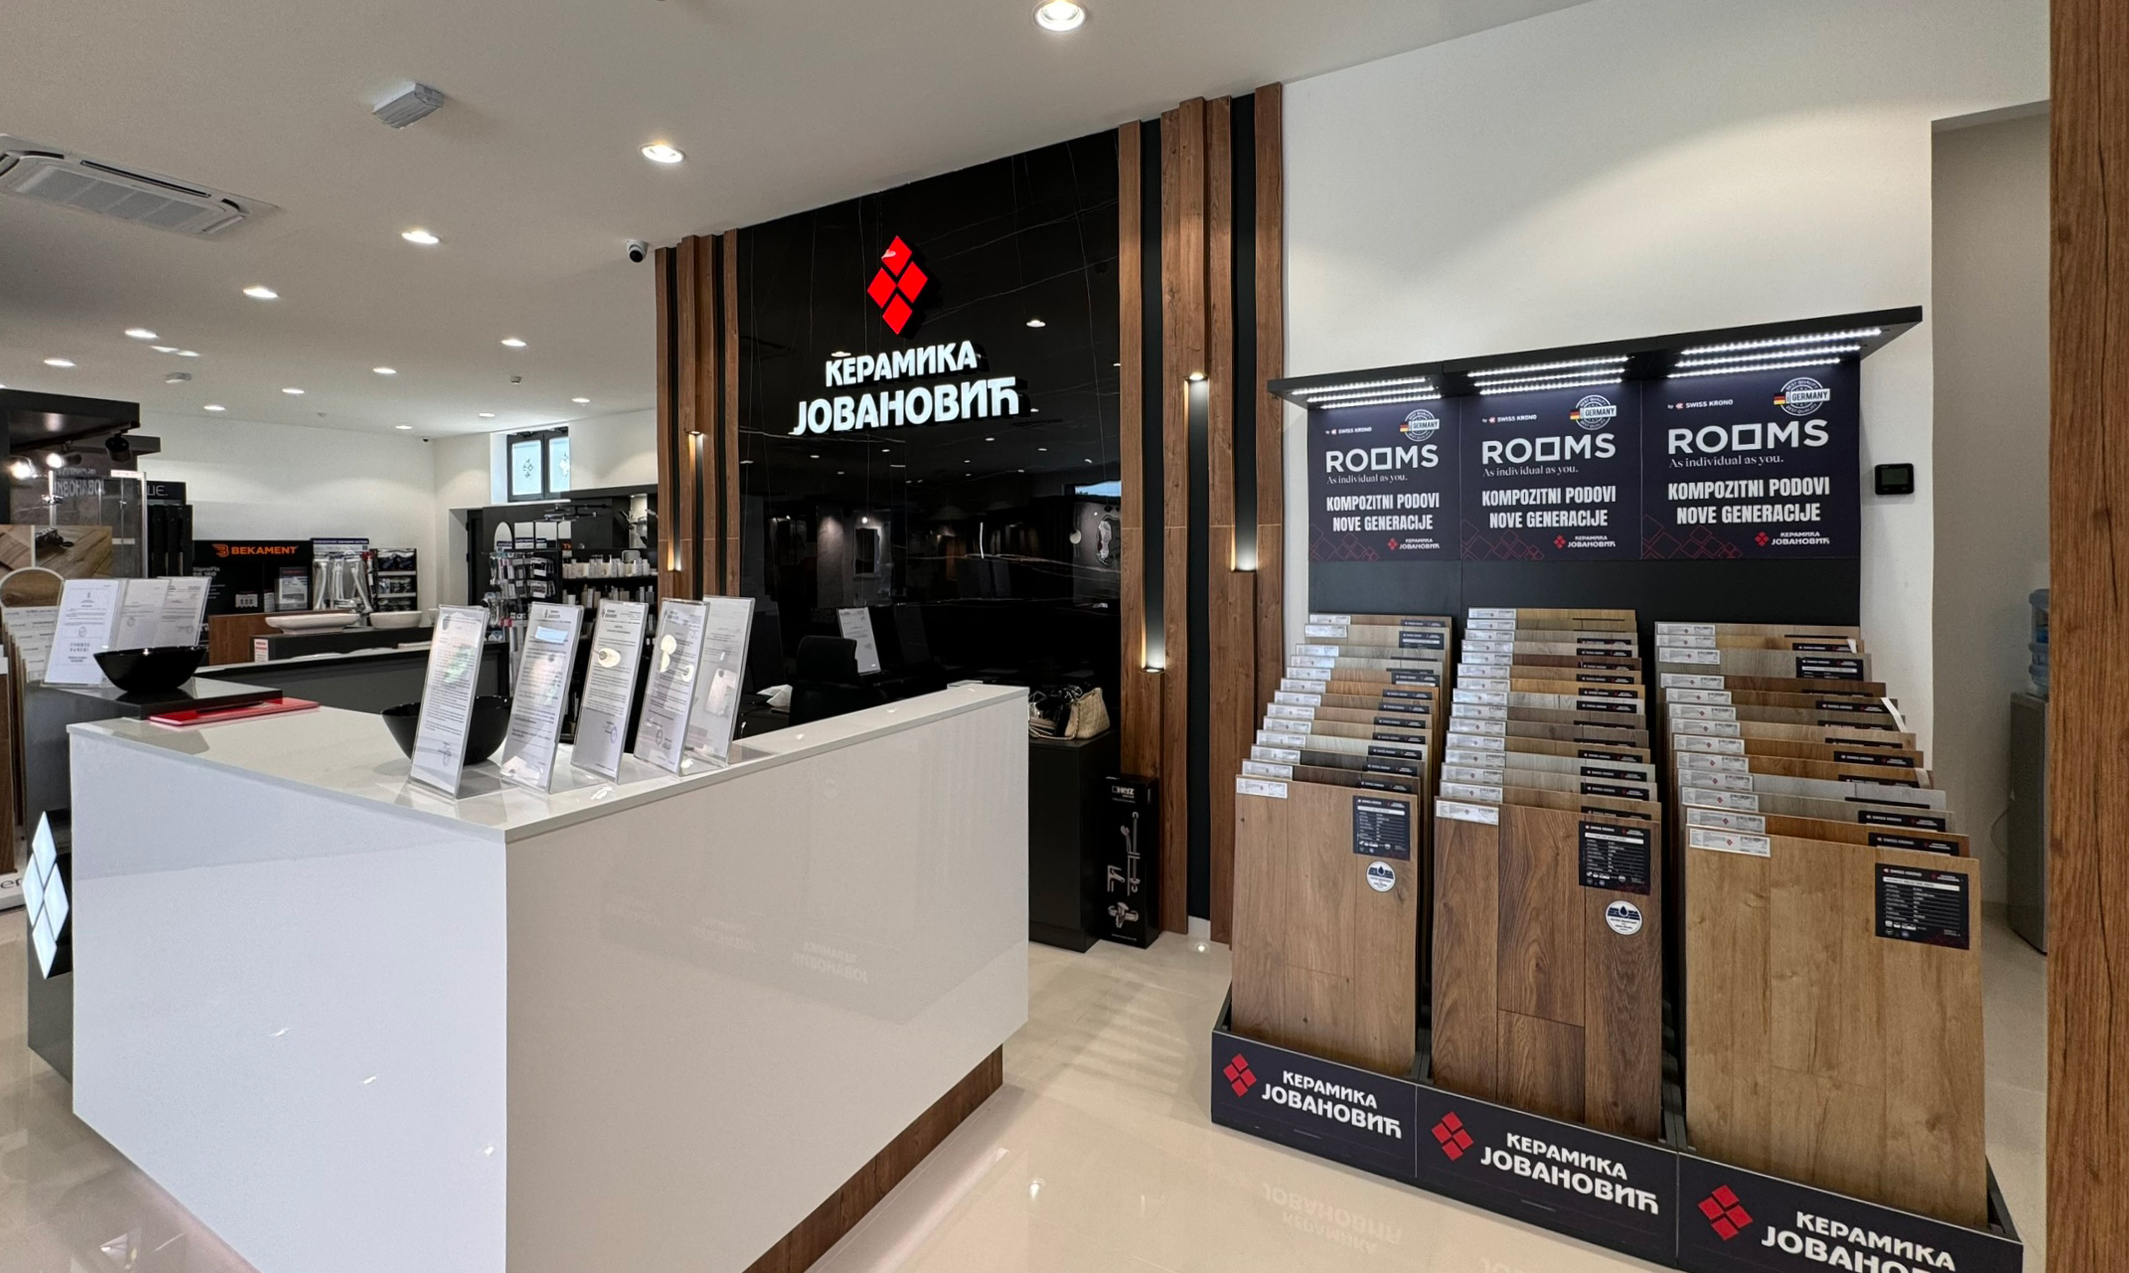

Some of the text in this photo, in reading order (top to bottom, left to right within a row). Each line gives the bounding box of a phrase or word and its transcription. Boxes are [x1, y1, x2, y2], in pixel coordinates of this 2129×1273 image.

[826, 340, 978, 387] КЕРАМИКА
[793, 376, 1020, 436] ЈОВАНОВИЋ
[1792, 390, 1828, 402] GERMANY
[1585, 408, 1615, 416] GERMANY
[1482, 468, 1495, 477] As
[1496, 466, 1542, 476] individual
[1557, 466, 1578, 476] you.
[1668, 458, 1684, 468] As
[1686, 455, 1741, 467] individual
[1758, 456, 1784, 466] you.
[1326, 476, 1336, 484] As
[1338, 474, 1378, 484] individual
[1390, 475, 1408, 483] you.
[1668, 476, 1830, 500] KOMPOZITNI PODOVI
[1326, 492, 1440, 512] KOMPOZITNI PODOVI
[1482, 486, 1616, 506] KOMPOZITNI PODOVI
[1333, 514, 1432, 532] NOVE GENERACIJE
[1490, 510, 1608, 528] NOVE GENERACIJE
[1676, 502, 1820, 524] NOVE GENERACIJE
[231, 546, 298, 555] BEKAMENT
[1282, 1070, 1377, 1109] КЕРАМИКА
[1262, 1083, 1402, 1140] ЈОВАНОВИЋ
[1506, 1132, 1628, 1180] КЕРАМИКА
[1480, 1146, 1659, 1215] ЈОВАНОВИЋ
[1796, 1211, 1956, 1272] КЕРАМИКА
